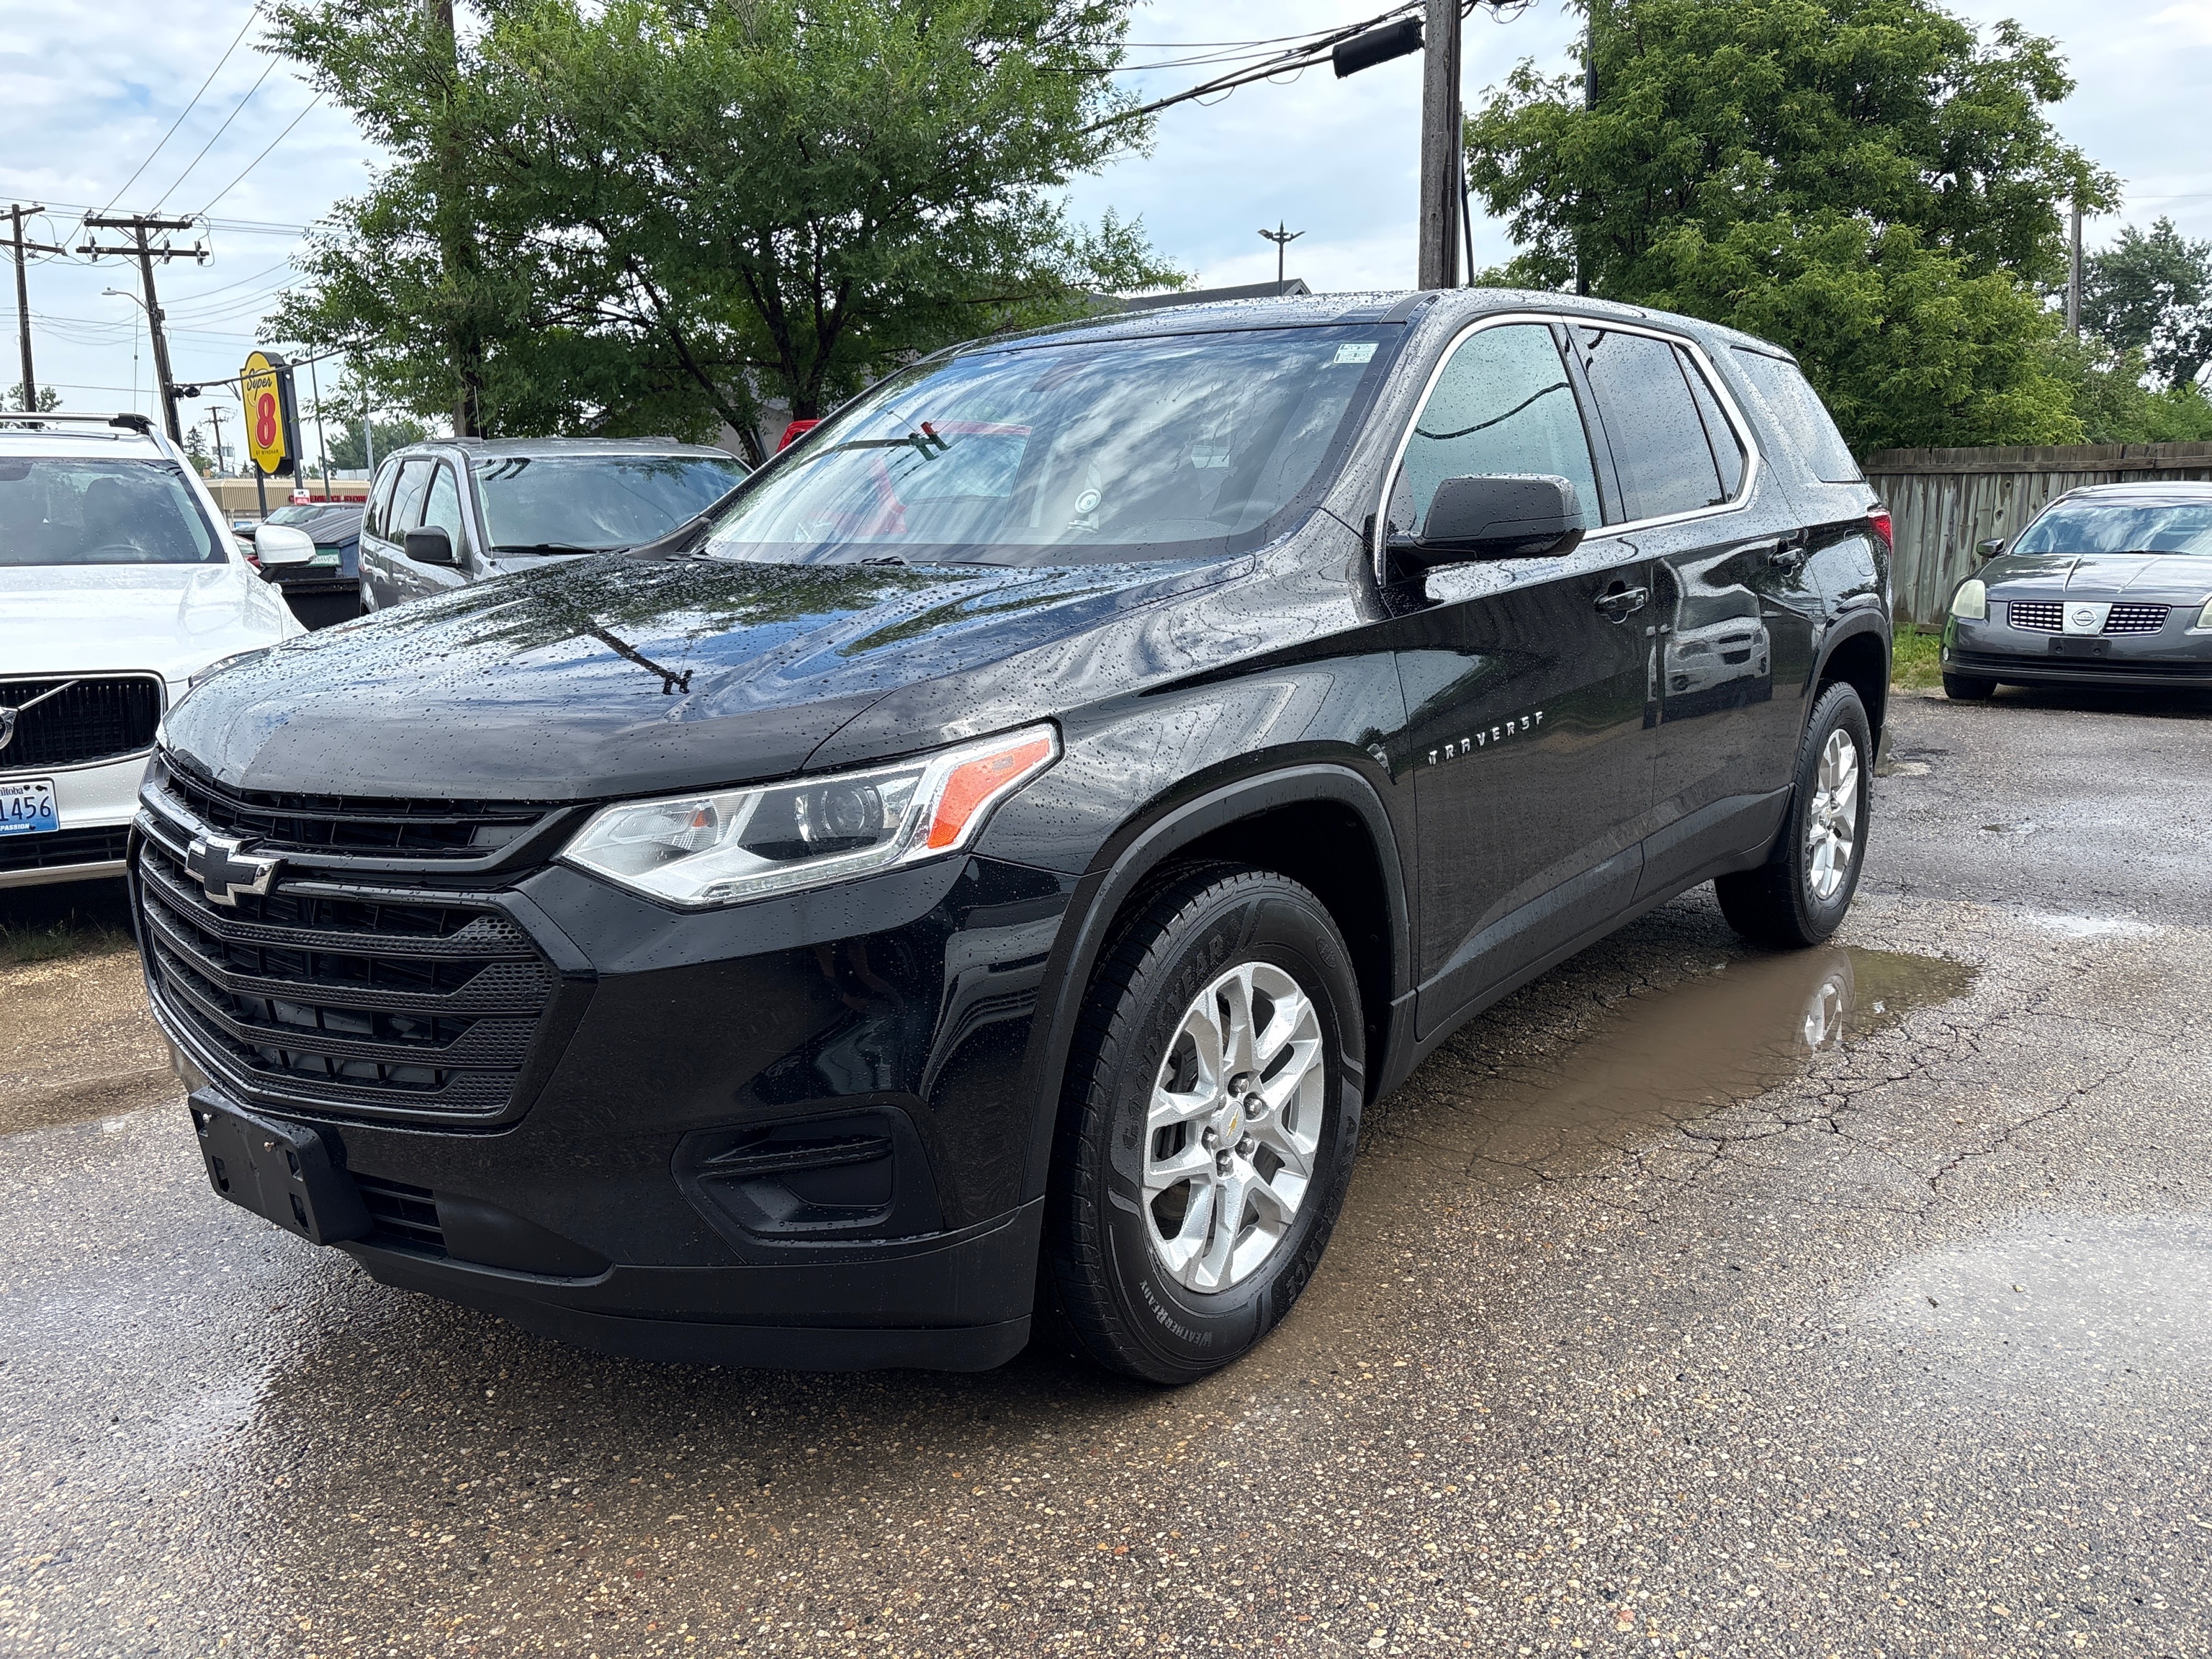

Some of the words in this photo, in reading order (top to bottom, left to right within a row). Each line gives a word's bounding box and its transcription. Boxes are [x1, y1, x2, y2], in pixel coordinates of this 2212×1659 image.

[247, 368, 272, 400] Super
[256, 392, 276, 449] 8
[1429, 711, 1543, 765] TRAVERSE
[0, 796, 51, 821] 1456
